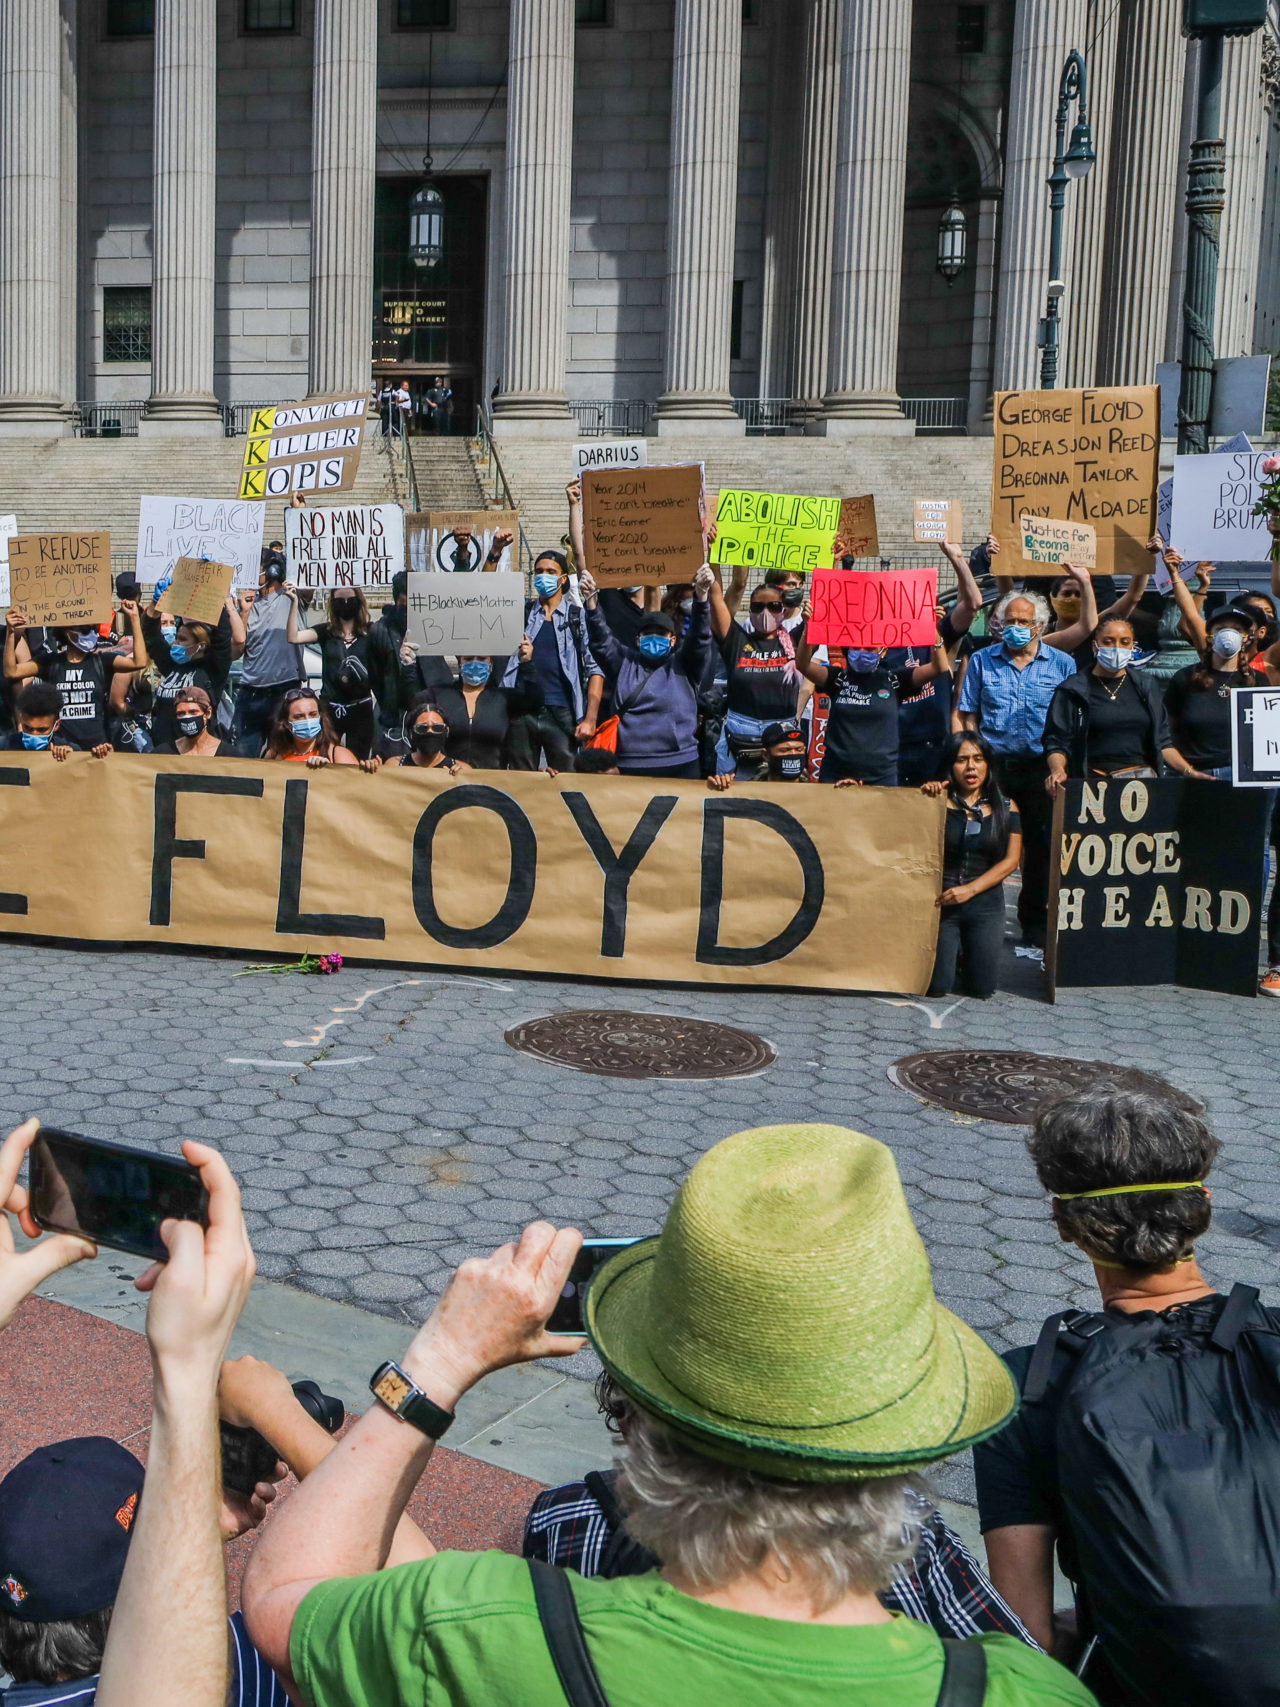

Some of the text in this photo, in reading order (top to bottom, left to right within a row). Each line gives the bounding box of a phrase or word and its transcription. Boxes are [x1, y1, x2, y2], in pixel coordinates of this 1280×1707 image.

[252, 400, 364, 433] KONVICT
[999, 390, 1143, 425] GEORGE FLOYD
[246, 428, 356, 465] KILLER
[1002, 427, 1156, 459] DREASJON REED
[578, 446, 639, 466] DARRIUS
[241, 459, 341, 495] KOPS
[1001, 460, 1139, 488] BREONNA TAYLOR
[592, 482, 646, 495] Year 2014
[173, 503, 262, 534] BLACK
[716, 492, 840, 530] ABOLISH
[1000, 495, 1050, 523] TONY
[1213, 508, 1270, 530] BRUTA
[300, 508, 384, 537] NO MAN IS
[750, 526, 794, 543] THE
[292, 536, 393, 560] FREE UNTIL ALL
[592, 532, 649, 543] Year 2020
[1024, 534, 1069, 551] Breonna
[1072, 529, 1089, 542] for
[9, 537, 103, 562] I REFUSE
[718, 537, 821, 571] POLICE
[1027, 549, 1064, 563] Taylor
[11, 563, 99, 581] TO BE ANOTHER
[297, 558, 394, 587] MEN ARE FREE
[635, 562, 666, 577] Floyd
[14, 575, 99, 602] COLOUR
[32, 603, 50, 611] THE
[55, 598, 86, 609] GROUND
[811, 579, 936, 624] BREONNA
[43, 613, 57, 622] NO
[64, 609, 94, 620] THREAT
[825, 622, 915, 646] TAYLOR
[56, 681, 95, 690] SKIN COLOR
[65, 669, 83, 681] MY
[70, 690, 93, 703] NOT
[62, 706, 92, 717] A CRIME
[1077, 780, 1149, 824] NO
[1060, 831, 1182, 876] VOICE
[149, 773, 825, 967] FLOYD
[1057, 885, 1251, 934] HEARD
